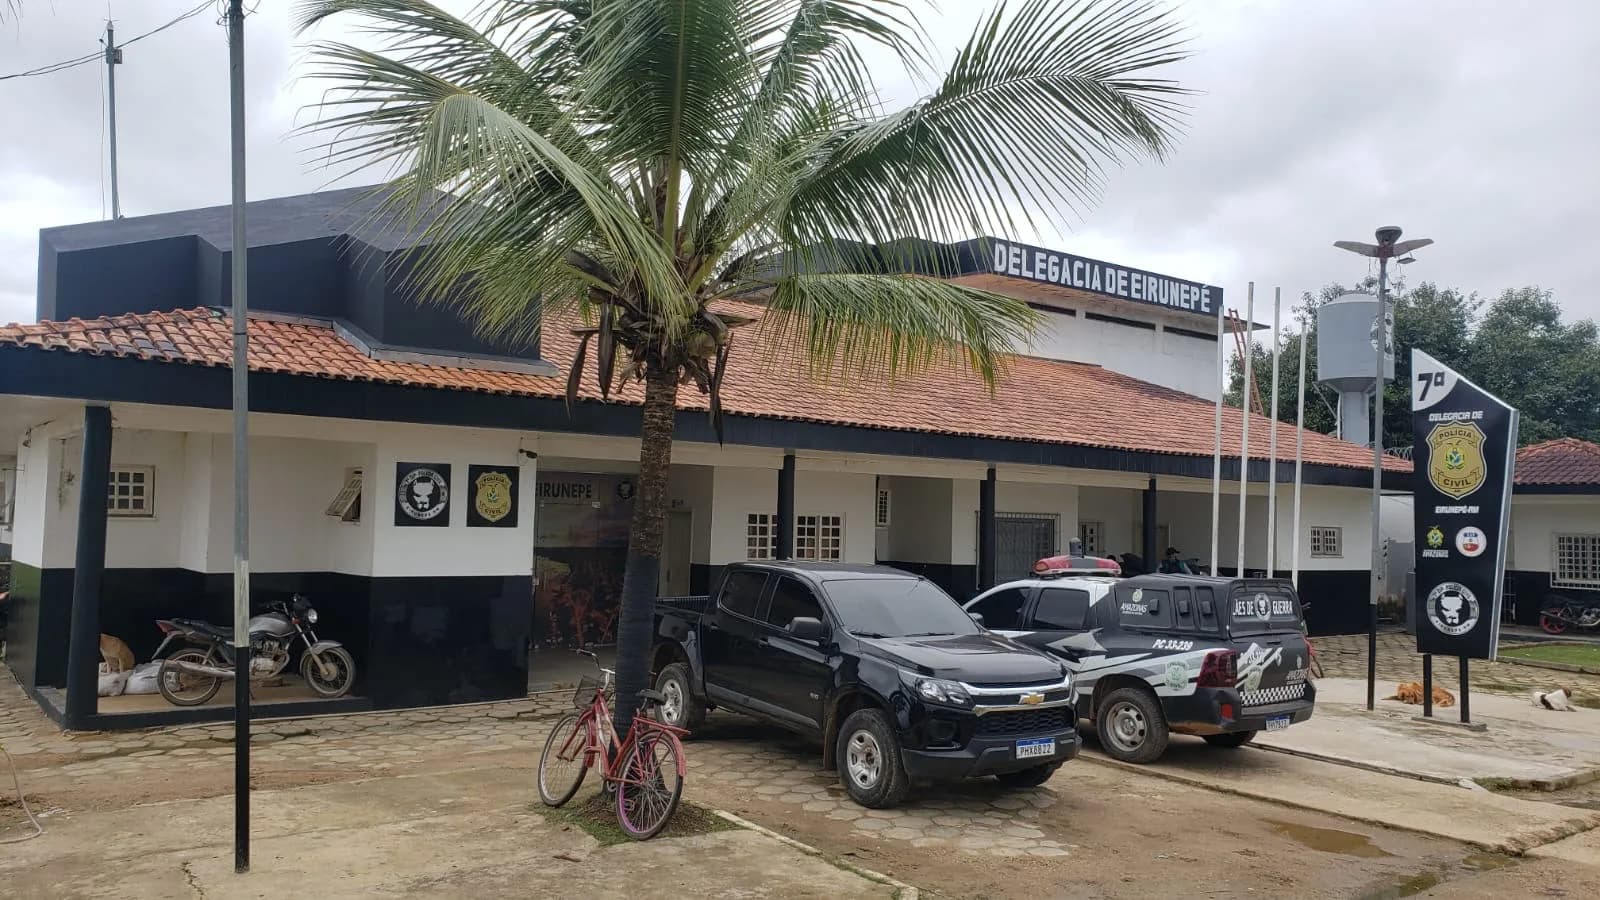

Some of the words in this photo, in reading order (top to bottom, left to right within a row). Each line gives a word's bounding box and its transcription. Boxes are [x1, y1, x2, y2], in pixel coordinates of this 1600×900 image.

[994, 242, 1102, 291] DELEGACIA
[1105, 267, 1128, 297] DE
[1131, 272, 1210, 312] EIRUNEPÉ
[1429, 412, 1471, 421] DELEGACIA
[1472, 411, 1484, 419] DE
[1439, 429, 1472, 439] POLÍCIA
[1443, 478, 1471, 487] CIVIL
[1272, 600, 1293, 615] GUERRA
[1152, 639, 1166, 649] PC
